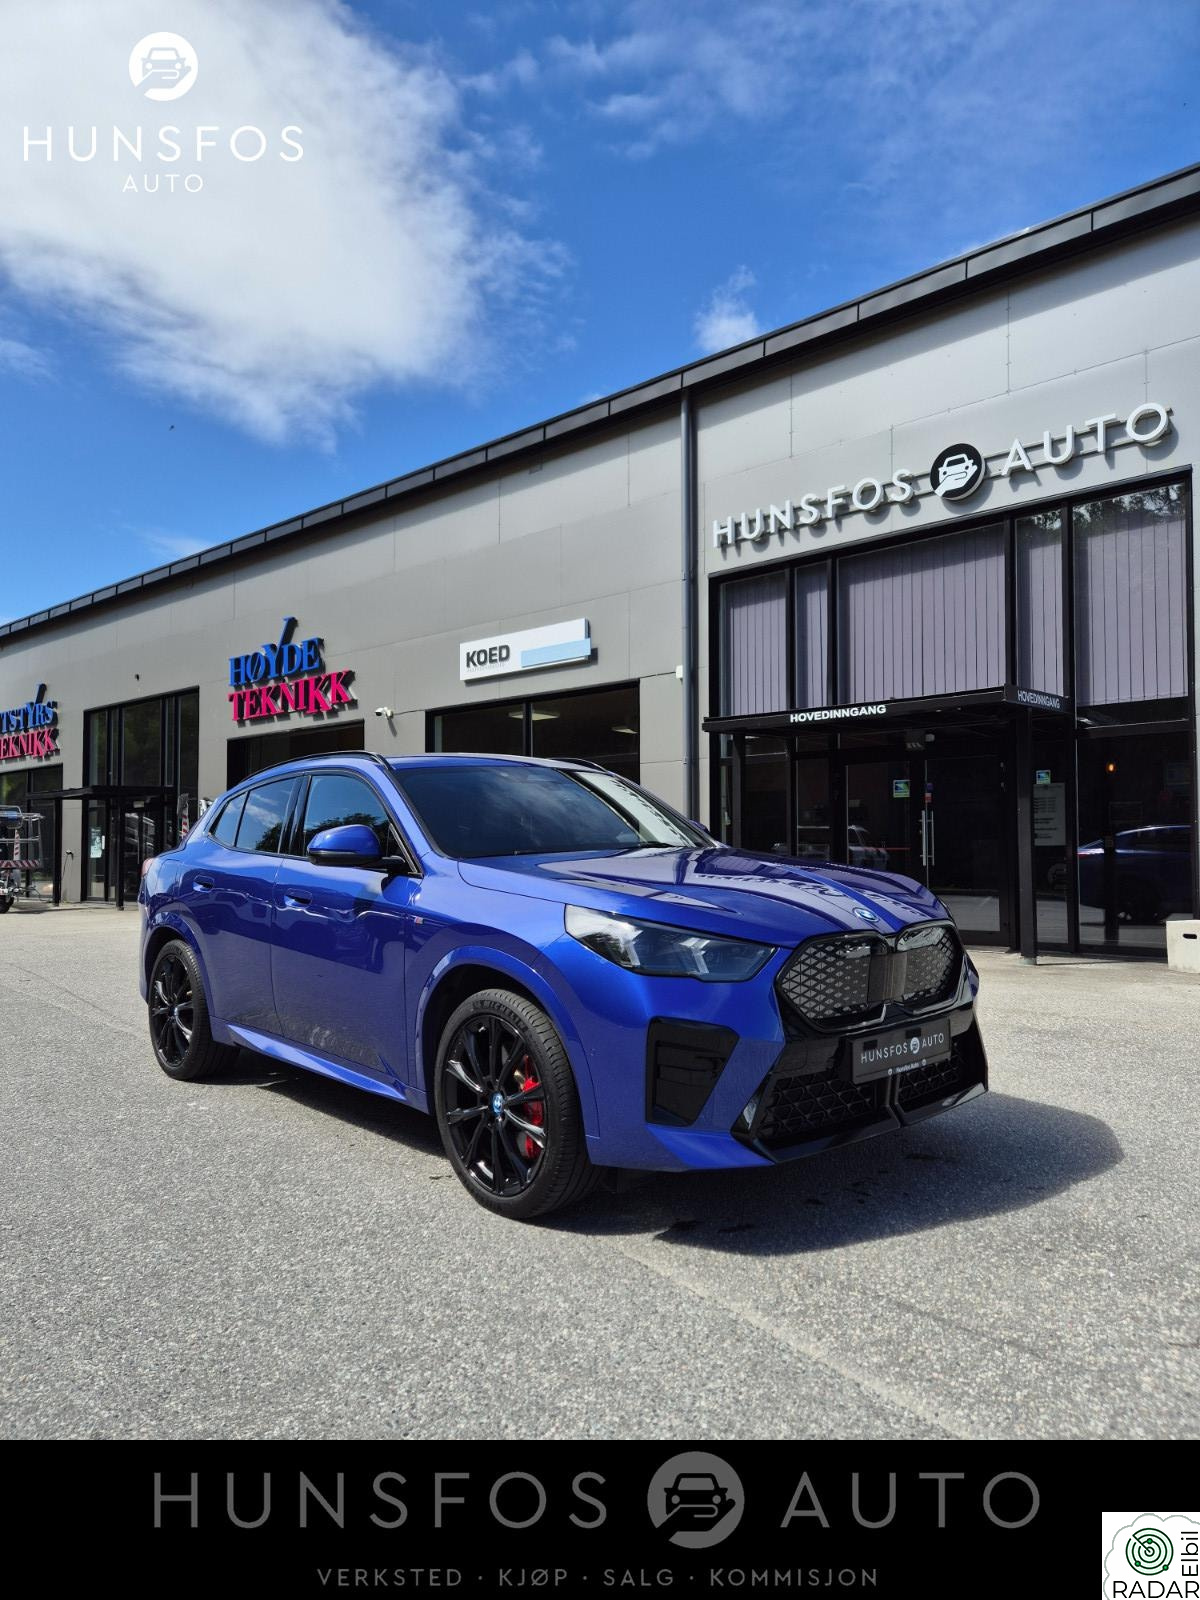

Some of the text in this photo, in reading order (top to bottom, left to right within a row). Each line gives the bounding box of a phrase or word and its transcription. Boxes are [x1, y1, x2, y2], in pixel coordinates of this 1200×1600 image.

[712, 402, 1169, 549] HUNSFOS AUTO
[228, 616, 322, 687] HØYDE
[465, 644, 511, 669] KOED
[228, 667, 354, 721] TEKNIKK
[1017, 689, 1061, 709] HOVEDINNGANG
[789, 704, 887, 723] HOVEDINNGANG
[860, 1032, 945, 1064] HUNSFOS AUTO
